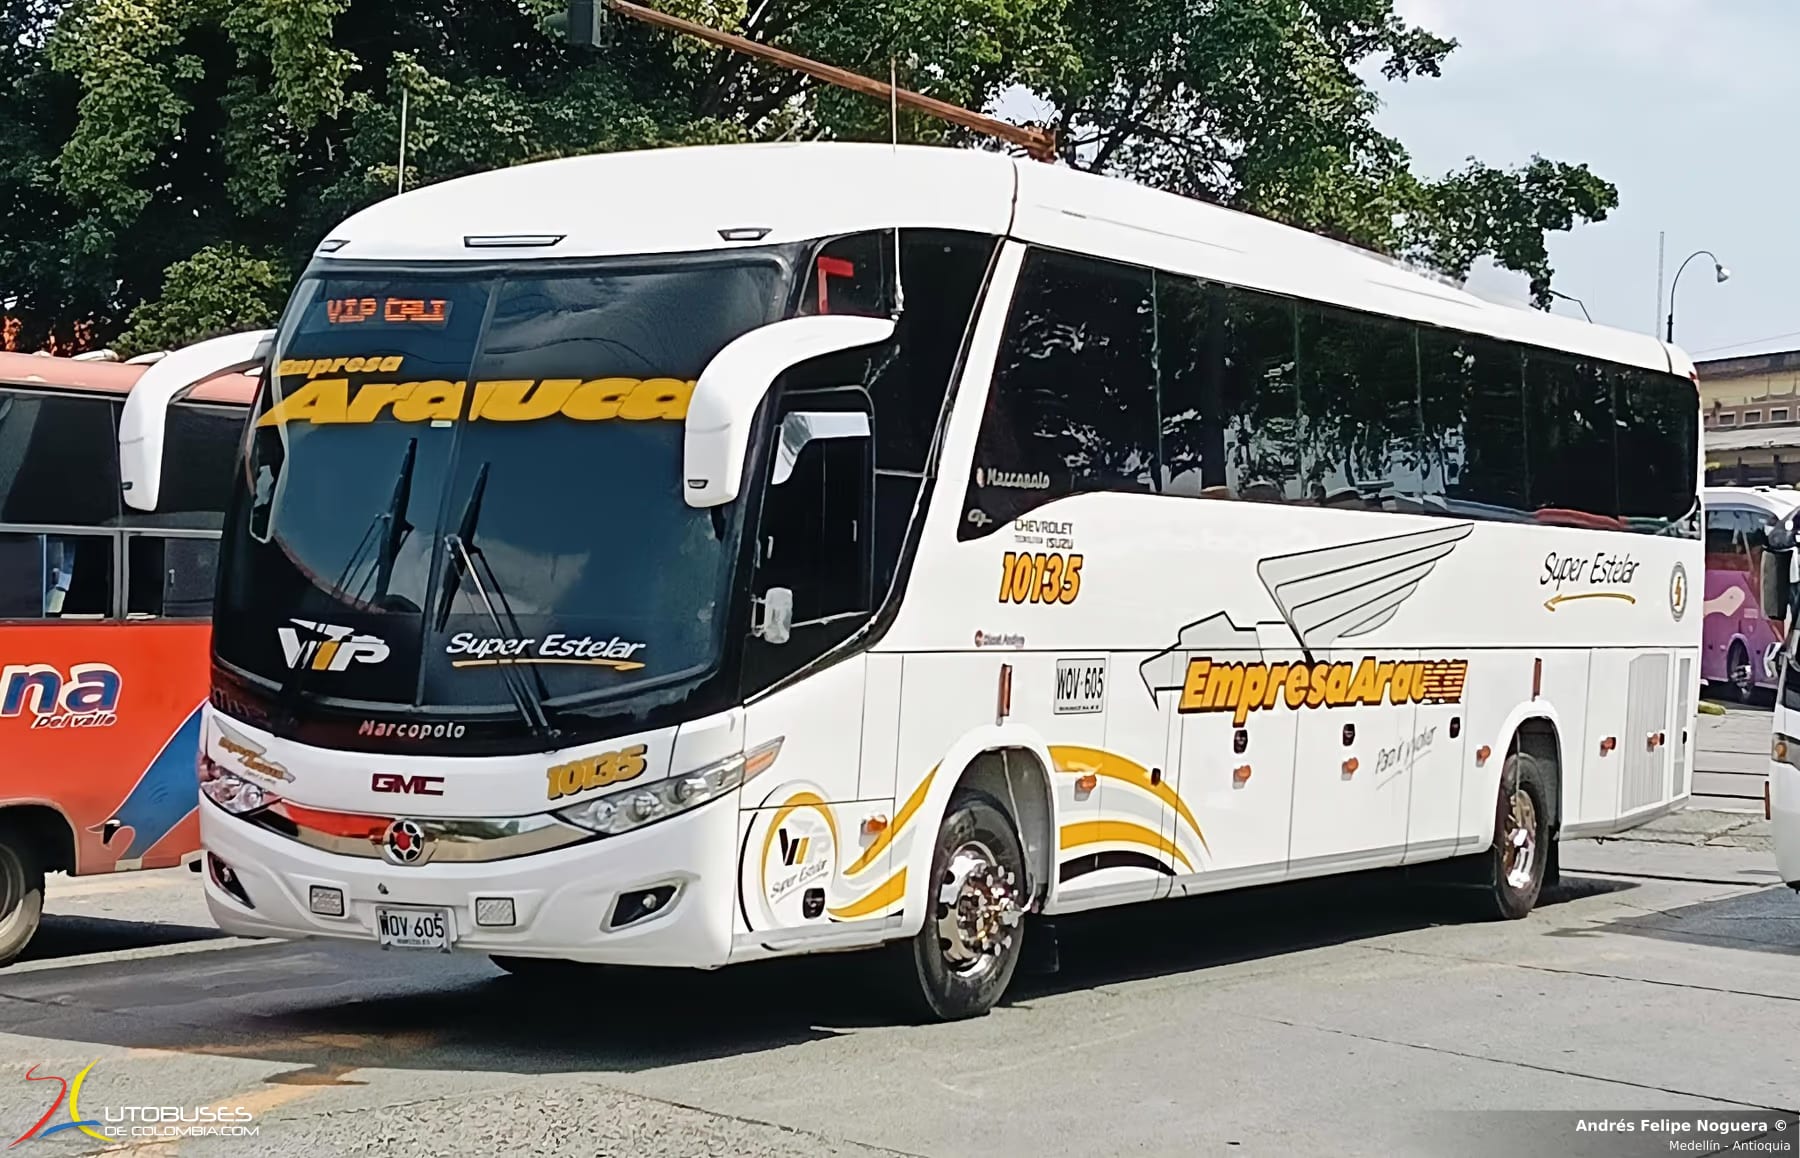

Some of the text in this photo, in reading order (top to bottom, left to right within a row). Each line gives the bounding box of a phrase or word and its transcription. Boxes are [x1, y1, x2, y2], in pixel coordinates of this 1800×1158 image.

[326, 297, 377, 323] VIP
[272, 355, 404, 379] Empresa
[1014, 518, 1073, 535] CHEVROLET
[1046, 537, 1074, 549] ISUZU
[998, 551, 1084, 604] 10135
[1539, 551, 1640, 591] Super Estelar
[446, 632, 647, 659] Super Estelar
[358, 720, 466, 740] Marcopolo
[546, 743, 649, 801] 10135
[371, 773, 445, 796] GMC
[414, 916, 445, 938] 605
